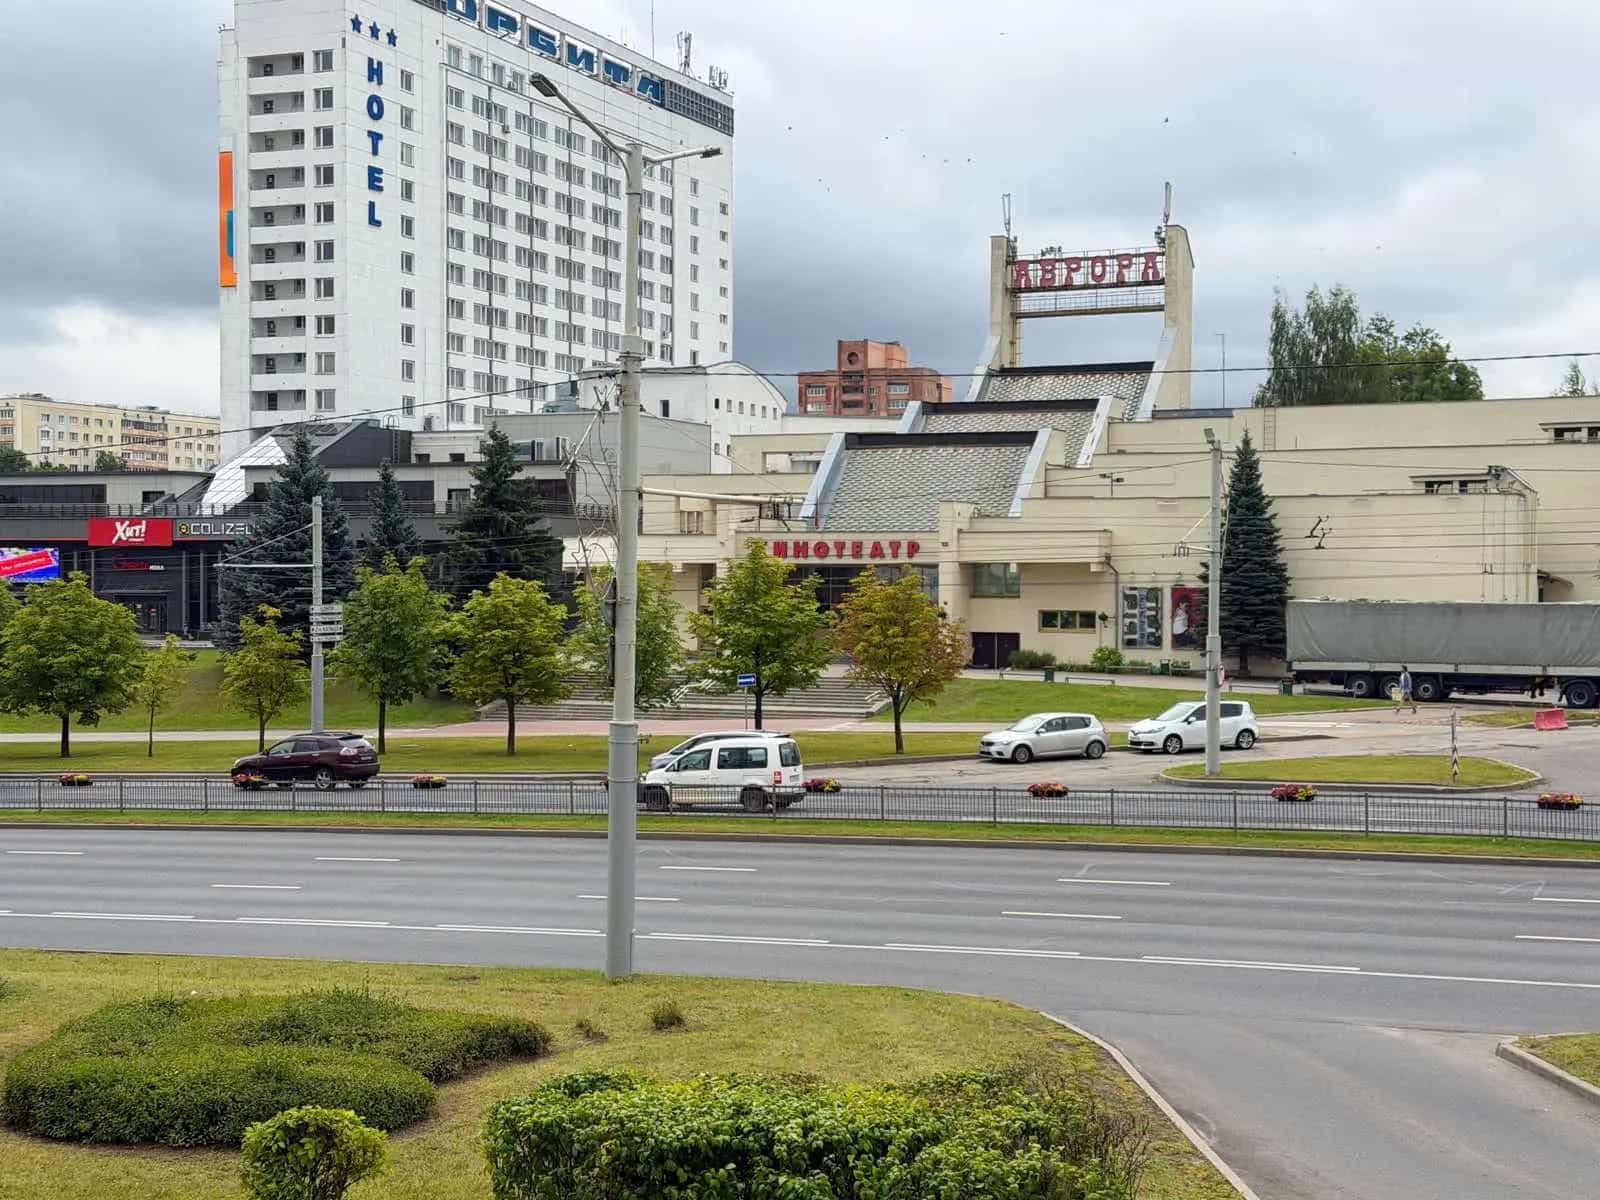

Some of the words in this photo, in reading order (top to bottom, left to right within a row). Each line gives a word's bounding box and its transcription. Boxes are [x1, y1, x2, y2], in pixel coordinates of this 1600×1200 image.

[366, 56, 384, 228] HOTEL
[1014, 252, 1162, 288] АВРОРА
[772, 541, 921, 559] ИНОТЕАТР
